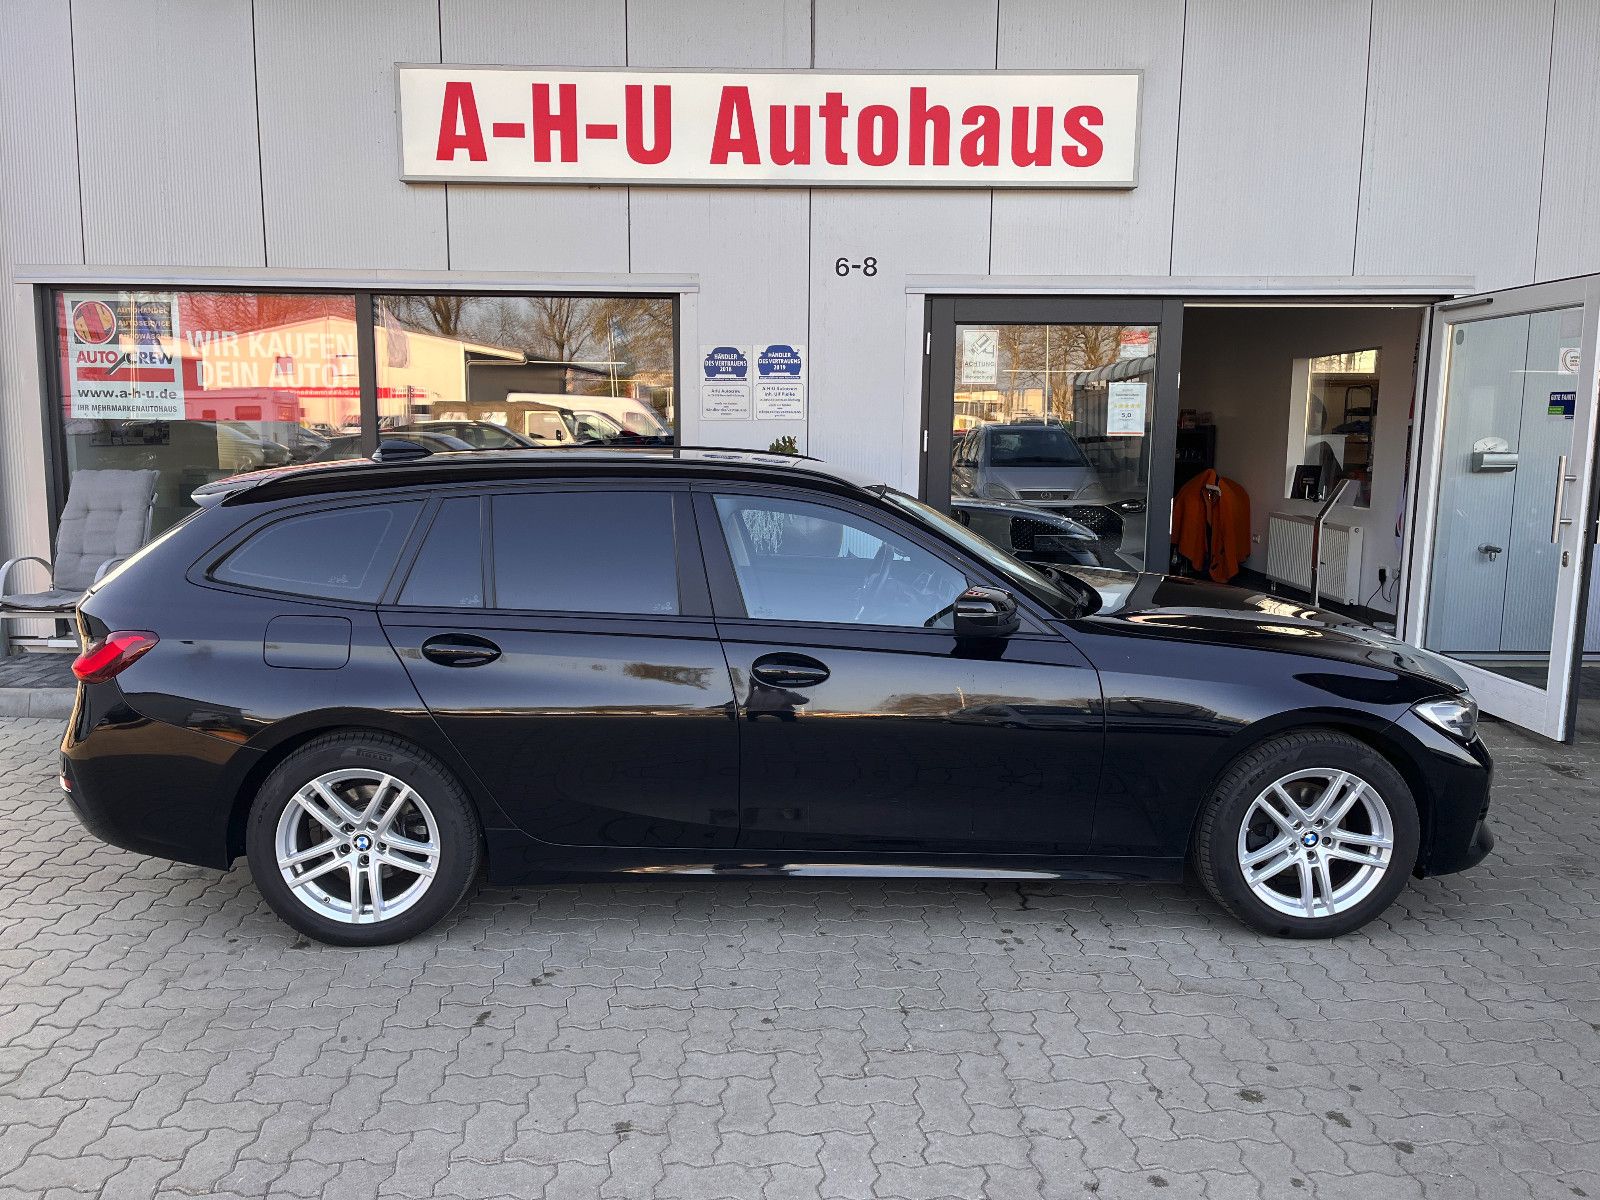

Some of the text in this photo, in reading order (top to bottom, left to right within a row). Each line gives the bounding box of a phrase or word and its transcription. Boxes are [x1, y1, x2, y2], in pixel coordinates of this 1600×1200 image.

[436, 81, 1105, 168] A-H-U Autohaus
[834, 256, 878, 278] 6-8
[118, 319, 171, 327] AUTOSERVICE
[185, 330, 355, 359] WIR KAUFEN
[77, 350, 119, 364] AUTO
[196, 361, 259, 388] DEIN
[77, 387, 178, 400] www.a-h-u.de
[77, 404, 178, 413] IHR MEHRMARKENAUTOHAUS
